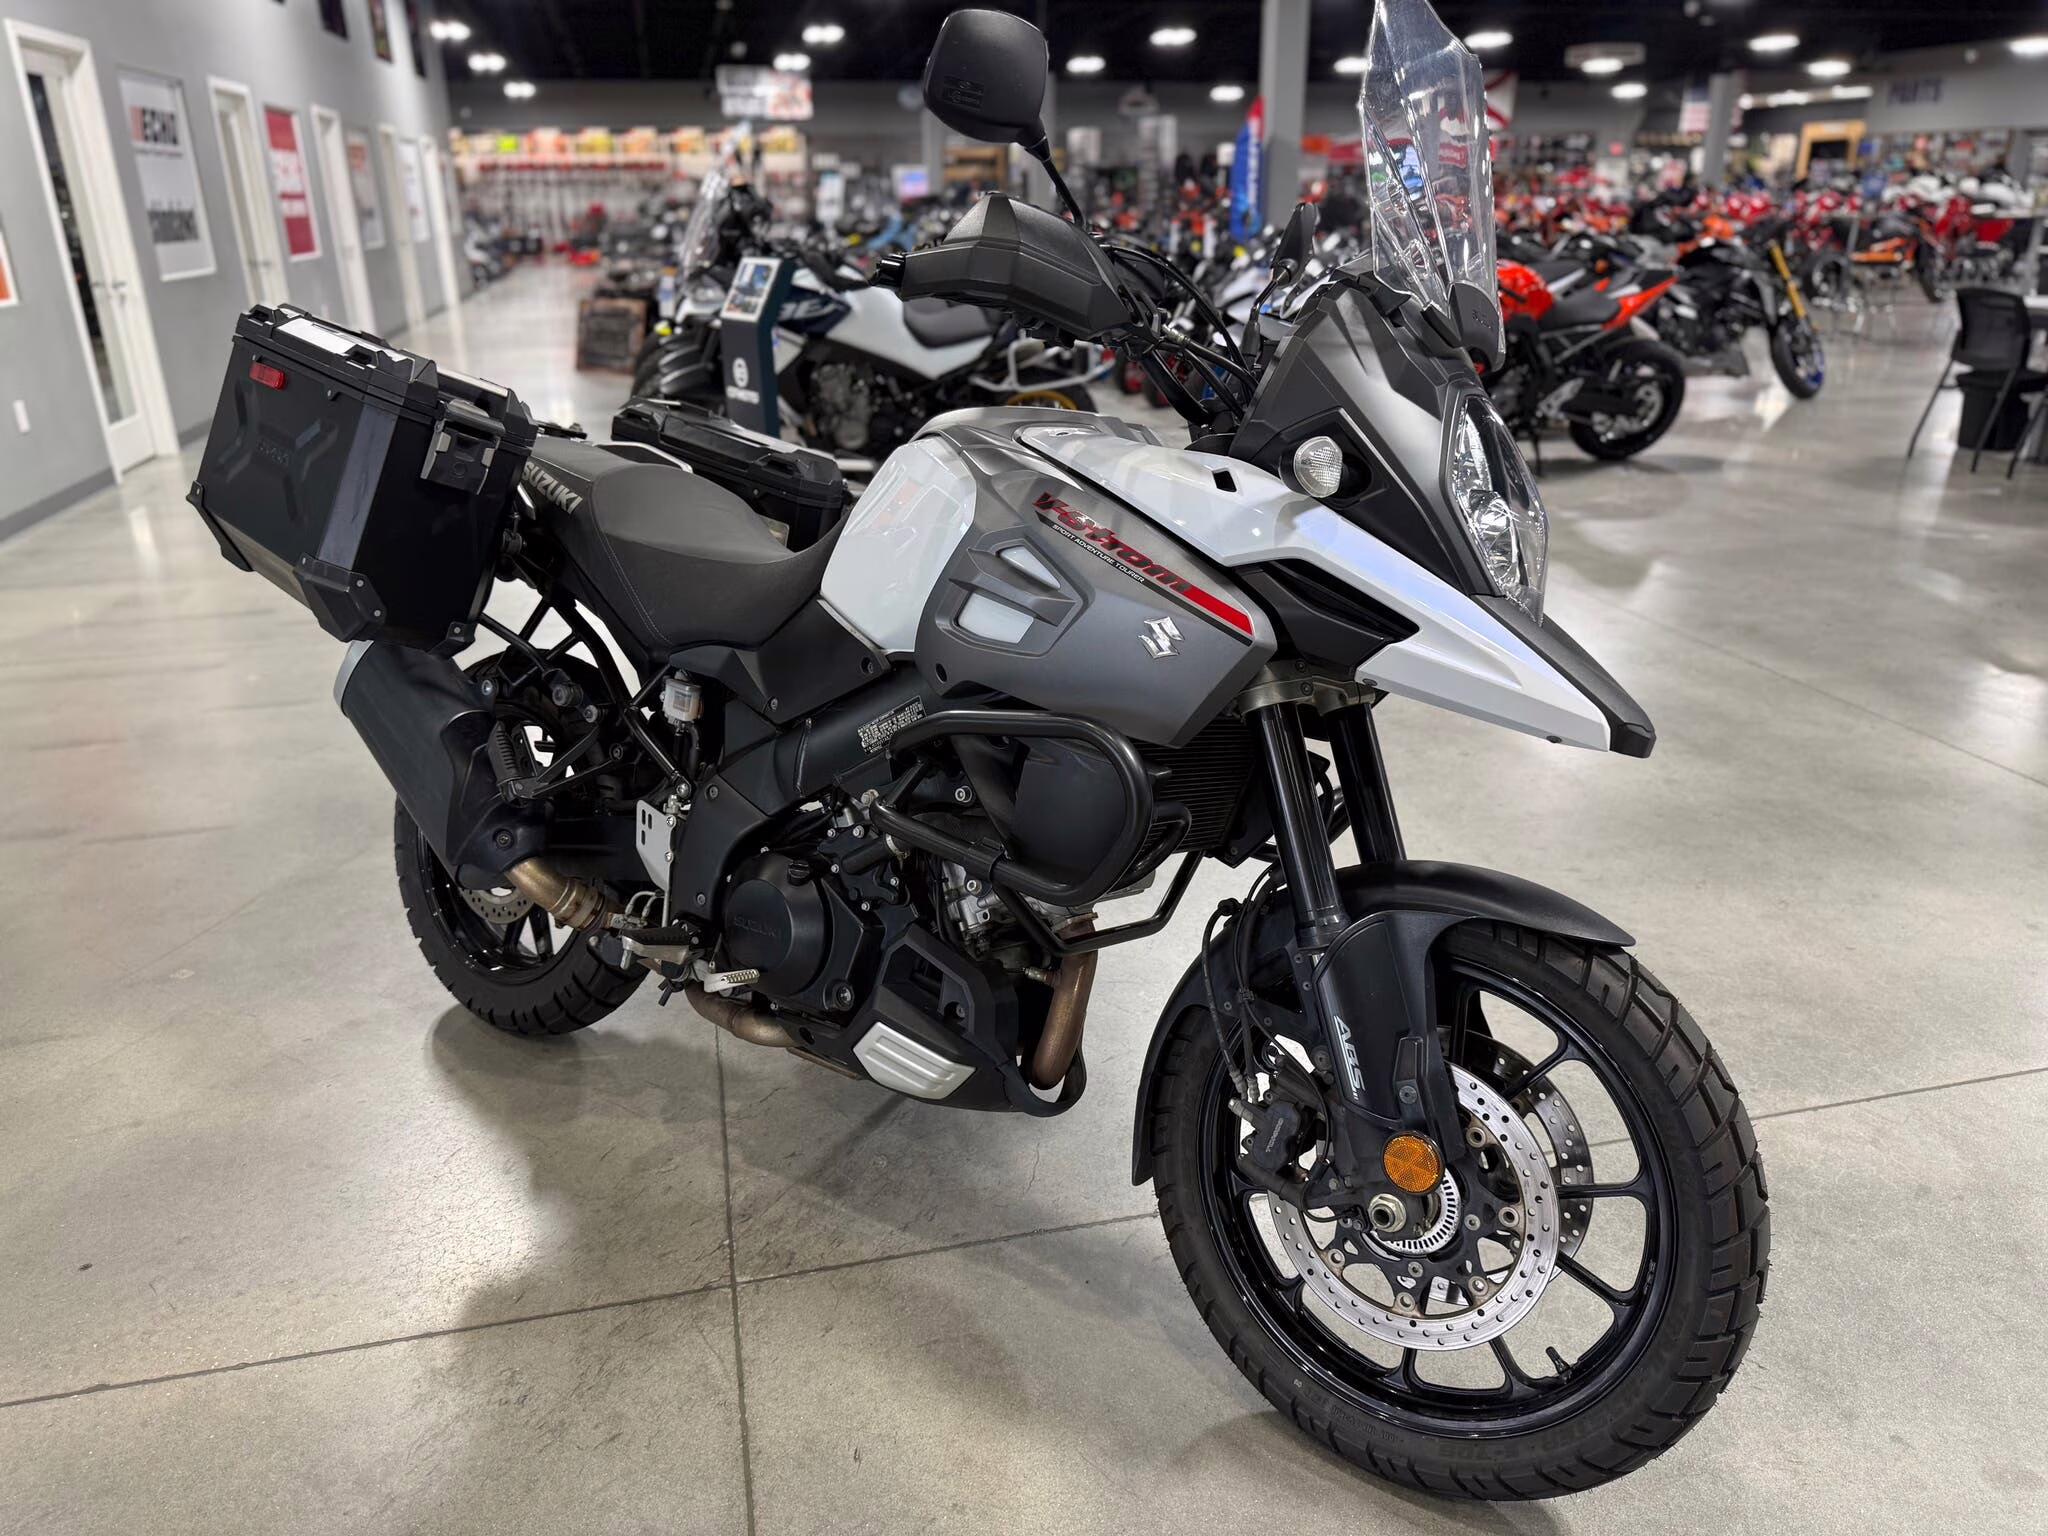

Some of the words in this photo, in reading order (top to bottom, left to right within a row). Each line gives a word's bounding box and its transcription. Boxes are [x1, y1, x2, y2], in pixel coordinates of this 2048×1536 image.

[521, 461, 583, 515] SUZUKI
[1032, 491, 1193, 594] V-Strom
[1052, 523, 1075, 540] SPORT
[1074, 538, 1115, 565] ADVENTURE
[1114, 562, 1146, 584] TOURER
[1334, 1015, 1366, 1092] ABS
